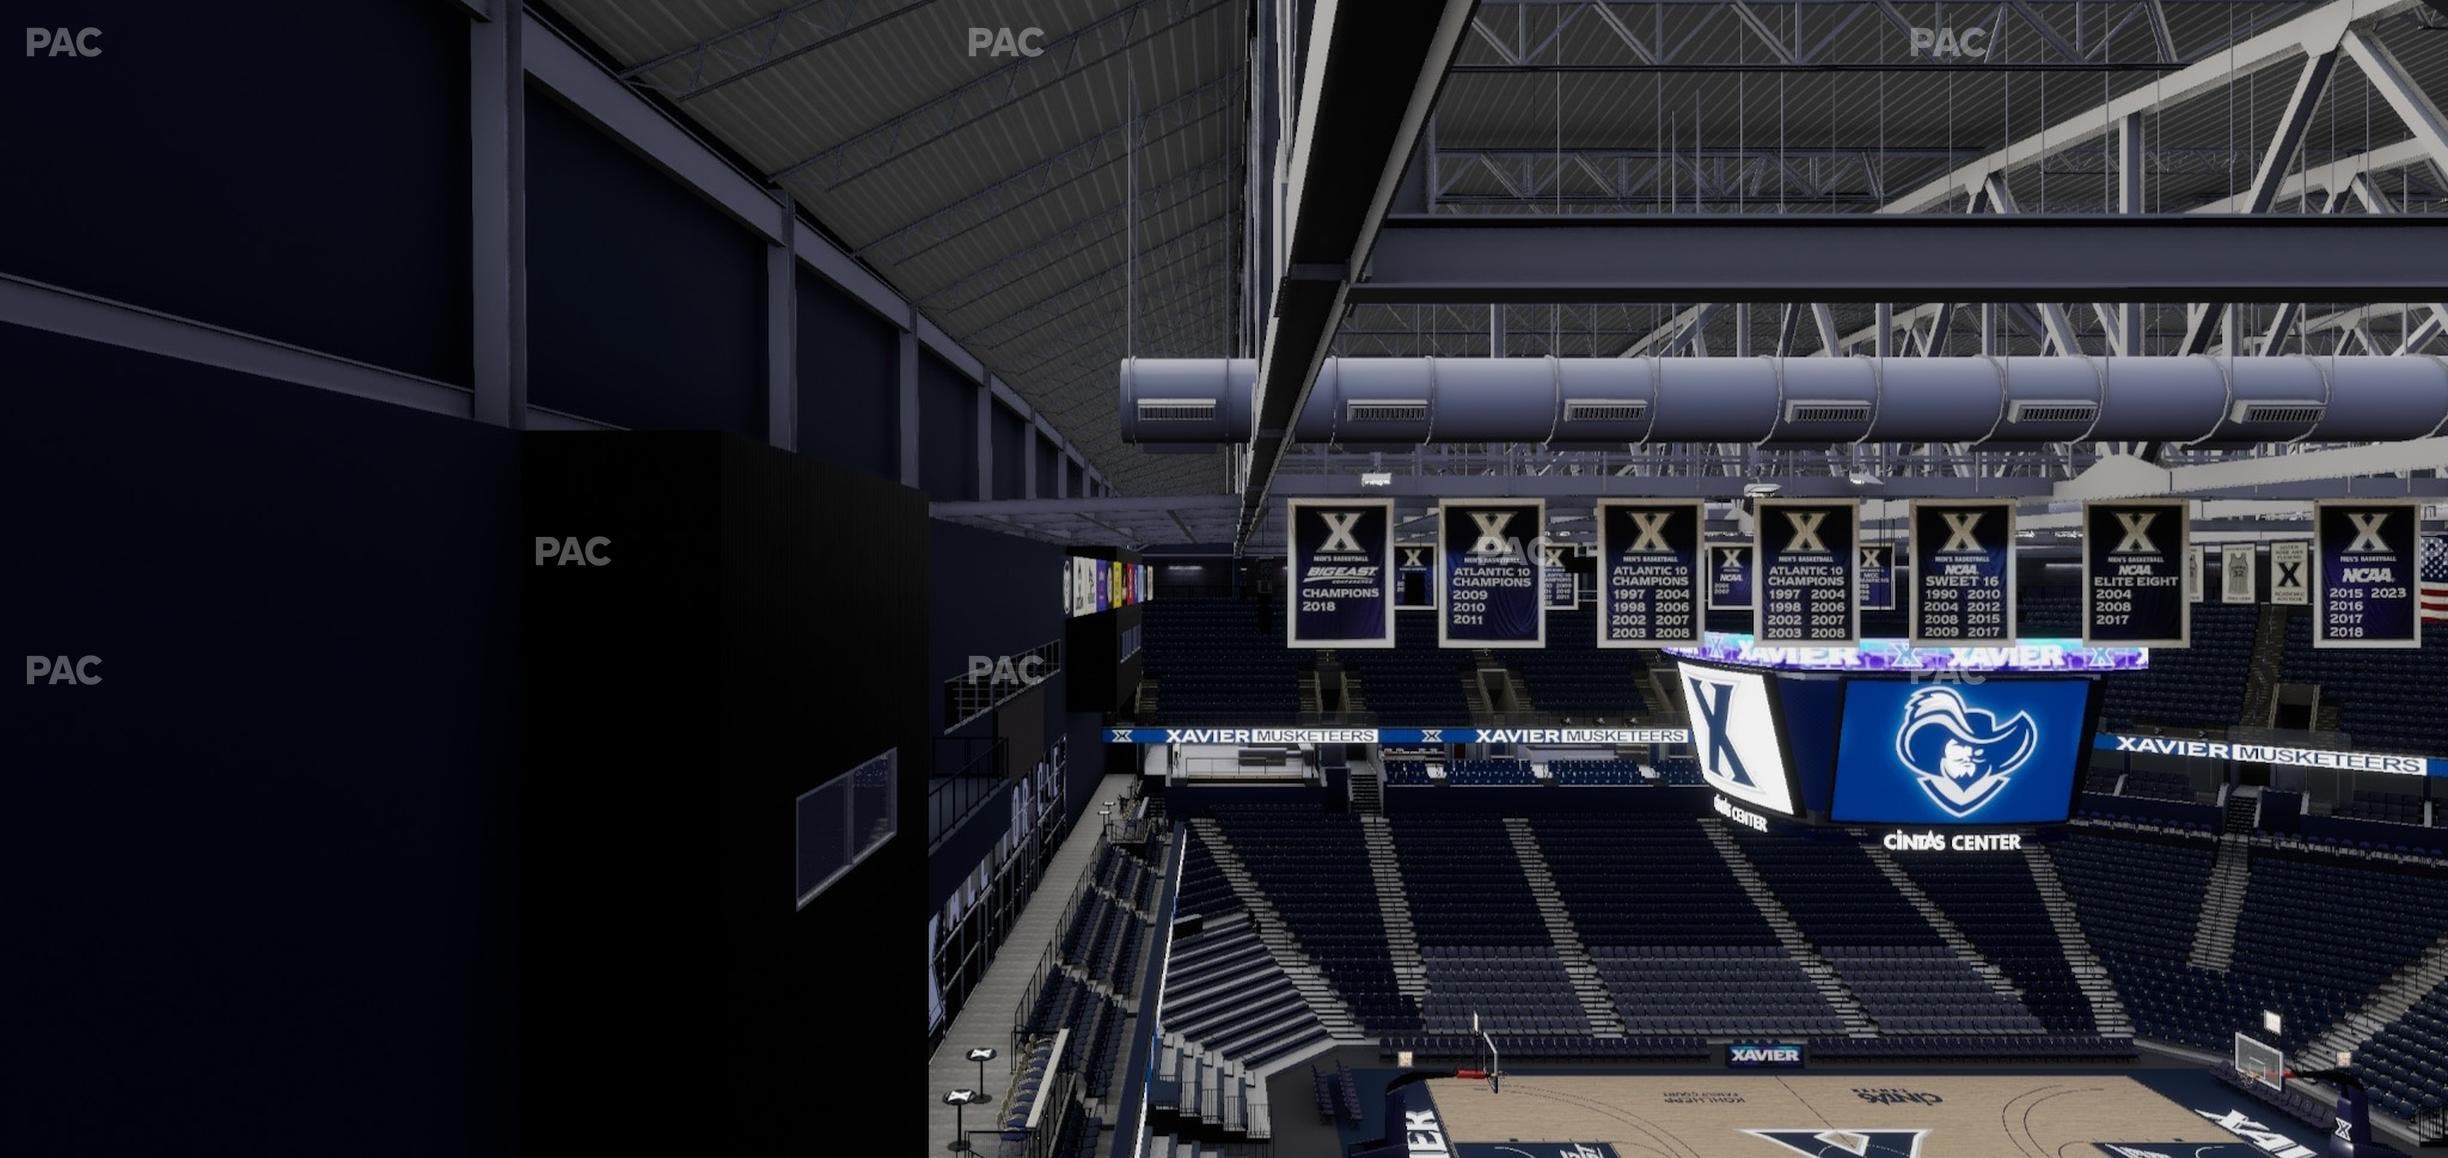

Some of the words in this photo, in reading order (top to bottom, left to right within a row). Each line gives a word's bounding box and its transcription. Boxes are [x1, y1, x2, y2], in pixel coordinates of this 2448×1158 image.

[1454, 568, 1515, 576] ATLANTIC
[1517, 568, 1531, 576] 10
[1613, 566, 1672, 575] ATLANTIC
[1675, 566, 1688, 575] 10
[1769, 566, 1828, 575] ATLANTIC
[1830, 566, 1843, 575] 10
[1945, 565, 1978, 575] NCAA
[2119, 565, 2152, 575] NCAA
[2276, 561, 2302, 587] X
[2342, 568, 2393, 583] NCAA
[1453, 577, 1532, 587] CHAMPIONS
[1612, 577, 1689, 586] CHAMPIONS
[1768, 577, 1844, 586] CHAMPIONS
[1925, 576, 1980, 586] SWEET
[1983, 576, 1999, 586] 16
[2094, 577, 2135, 586] ELITE
[2137, 577, 2179, 586] EIGHT
[1302, 588, 1379, 598] CHAMPIONS
[1453, 590, 1488, 600] 2009
[1614, 589, 1646, 599] 1997
[1655, 589, 1690, 599] 2004
[1769, 589, 1801, 599] 1997
[1811, 589, 1845, 599] 2004
[1925, 589, 1958, 599] 1990
[1967, 589, 2000, 599] 2010
[2096, 589, 2131, 599] 2004
[2329, 588, 2363, 598] 2015
[2371, 588, 2406, 598] 2023
[1302, 602, 1336, 612] 2018
[1453, 602, 1486, 612] 2010
[1614, 602, 1646, 612] 1998
[1655, 602, 1690, 612] 2006
[1769, 602, 1801, 612] 1998
[1811, 602, 1845, 612] 2006
[1925, 602, 1958, 612] 2004
[1967, 602, 2000, 612] 2012
[2096, 602, 2131, 612] 2008
[2329, 601, 2364, 611] 2016
[1453, 615, 1483, 625] 2011
[1612, 615, 1646, 625] 2002
[1655, 615, 1690, 625] 2007
[1768, 615, 1801, 625] 2002
[1811, 615, 1845, 625] 2007
[1925, 614, 1958, 624] 2008
[1967, 614, 2000, 624] 2015
[2096, 615, 2129, 625] 2017
[2329, 614, 2363, 624] 2017
[1612, 628, 1646, 638] 2003
[1655, 628, 1690, 638] 2008
[1768, 628, 1801, 638] 2003
[1811, 628, 1845, 638] 2008
[1925, 627, 1958, 637] 2009
[1967, 627, 2000, 637] 2017
[2330, 627, 2364, 637] 2018
[1737, 641, 1861, 668] XAVIER
[1950, 645, 2063, 668] XAVIER
[1166, 729, 1250, 743] XAVIER
[1256, 729, 1375, 742] MUSKETEERS
[1475, 729, 1561, 743] XAVIER
[1566, 729, 1685, 742] MUSKETEERS
[2116, 735, 2230, 760] XAVIER
[2239, 746, 2421, 773] MUSKETEERS
[1951, 833, 2022, 851] CENTER
[1731, 1048, 1800, 1062] XAVIER
